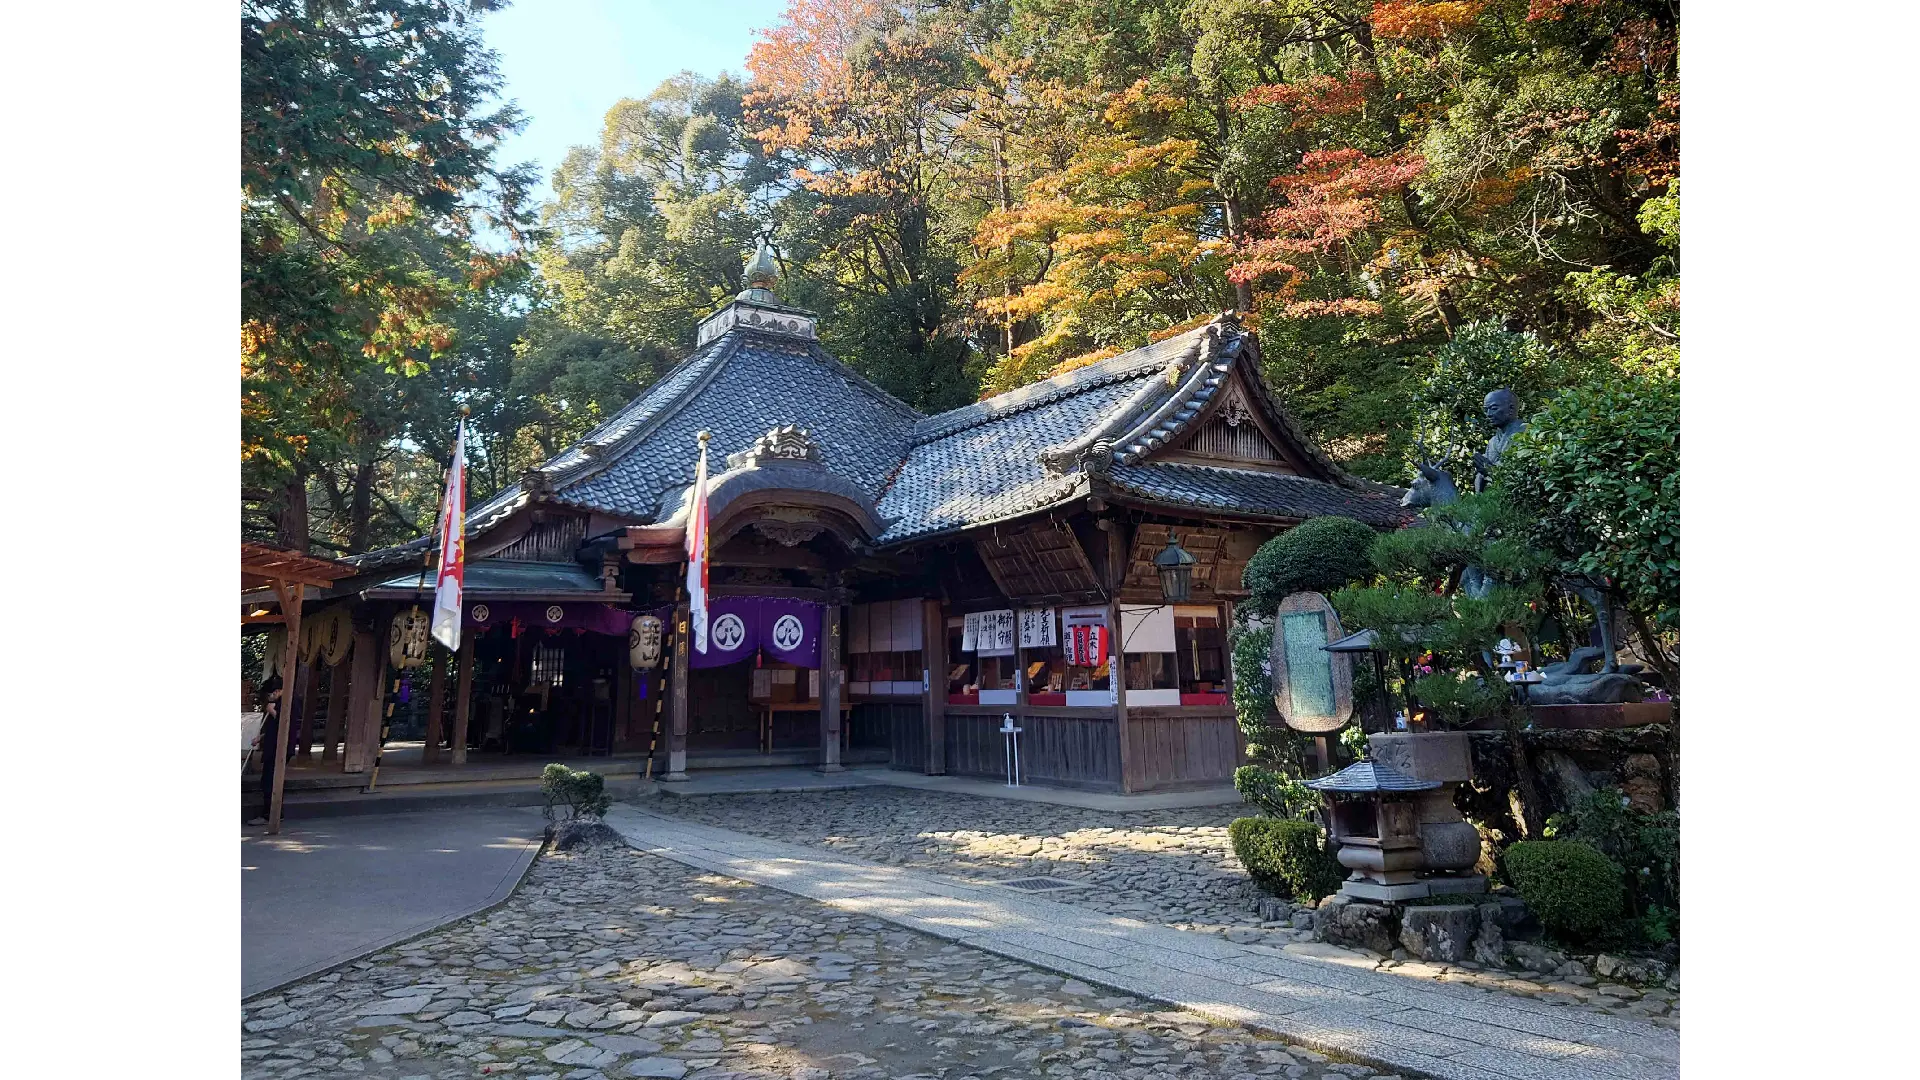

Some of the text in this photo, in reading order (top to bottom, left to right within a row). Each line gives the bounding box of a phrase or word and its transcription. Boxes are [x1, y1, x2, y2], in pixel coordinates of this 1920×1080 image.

[997, 613, 1006, 645] 御守
[1089, 631, 1098, 661] 立木山
